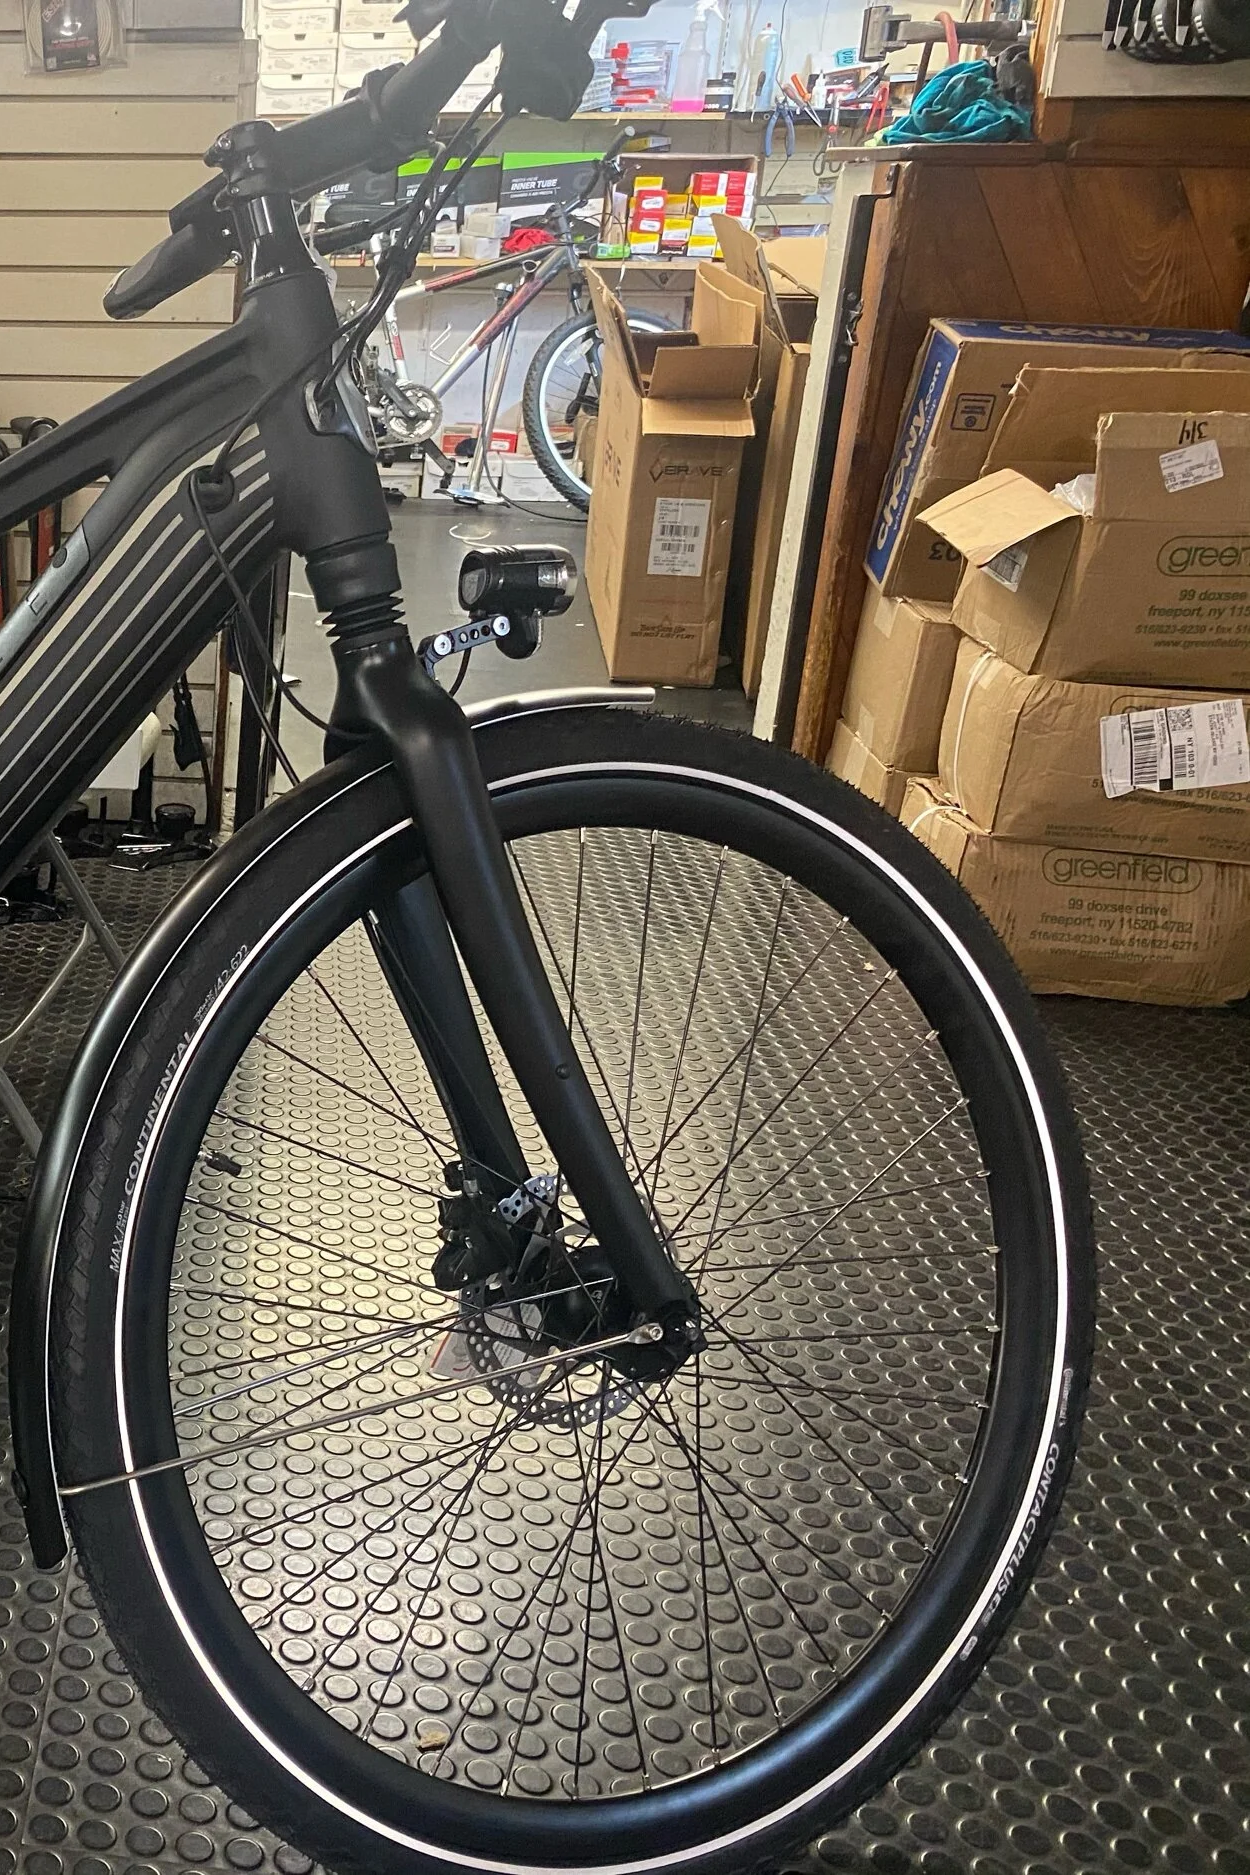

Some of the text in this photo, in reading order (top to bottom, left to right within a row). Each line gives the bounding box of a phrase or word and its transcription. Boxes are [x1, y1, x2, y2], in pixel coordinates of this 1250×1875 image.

[510, 181, 536, 191] INNER
[537, 178, 558, 189] TUBE
[1179, 588, 1196, 602] 99
[1207, 607, 1226, 620] ny
[1186, 737, 1194, 747] NY
[1053, 857, 1189, 885] greenfield
[1067, 897, 1168, 917] 99 doxsee drive
[1040, 911, 1095, 929] freeport,
[1099, 918, 1115, 931] ny
[1109, 934, 1125, 947] fax
[125, 1030, 195, 1197] CONTINENTAL
[997, 1442, 1060, 1596] CONTACTPLUS
